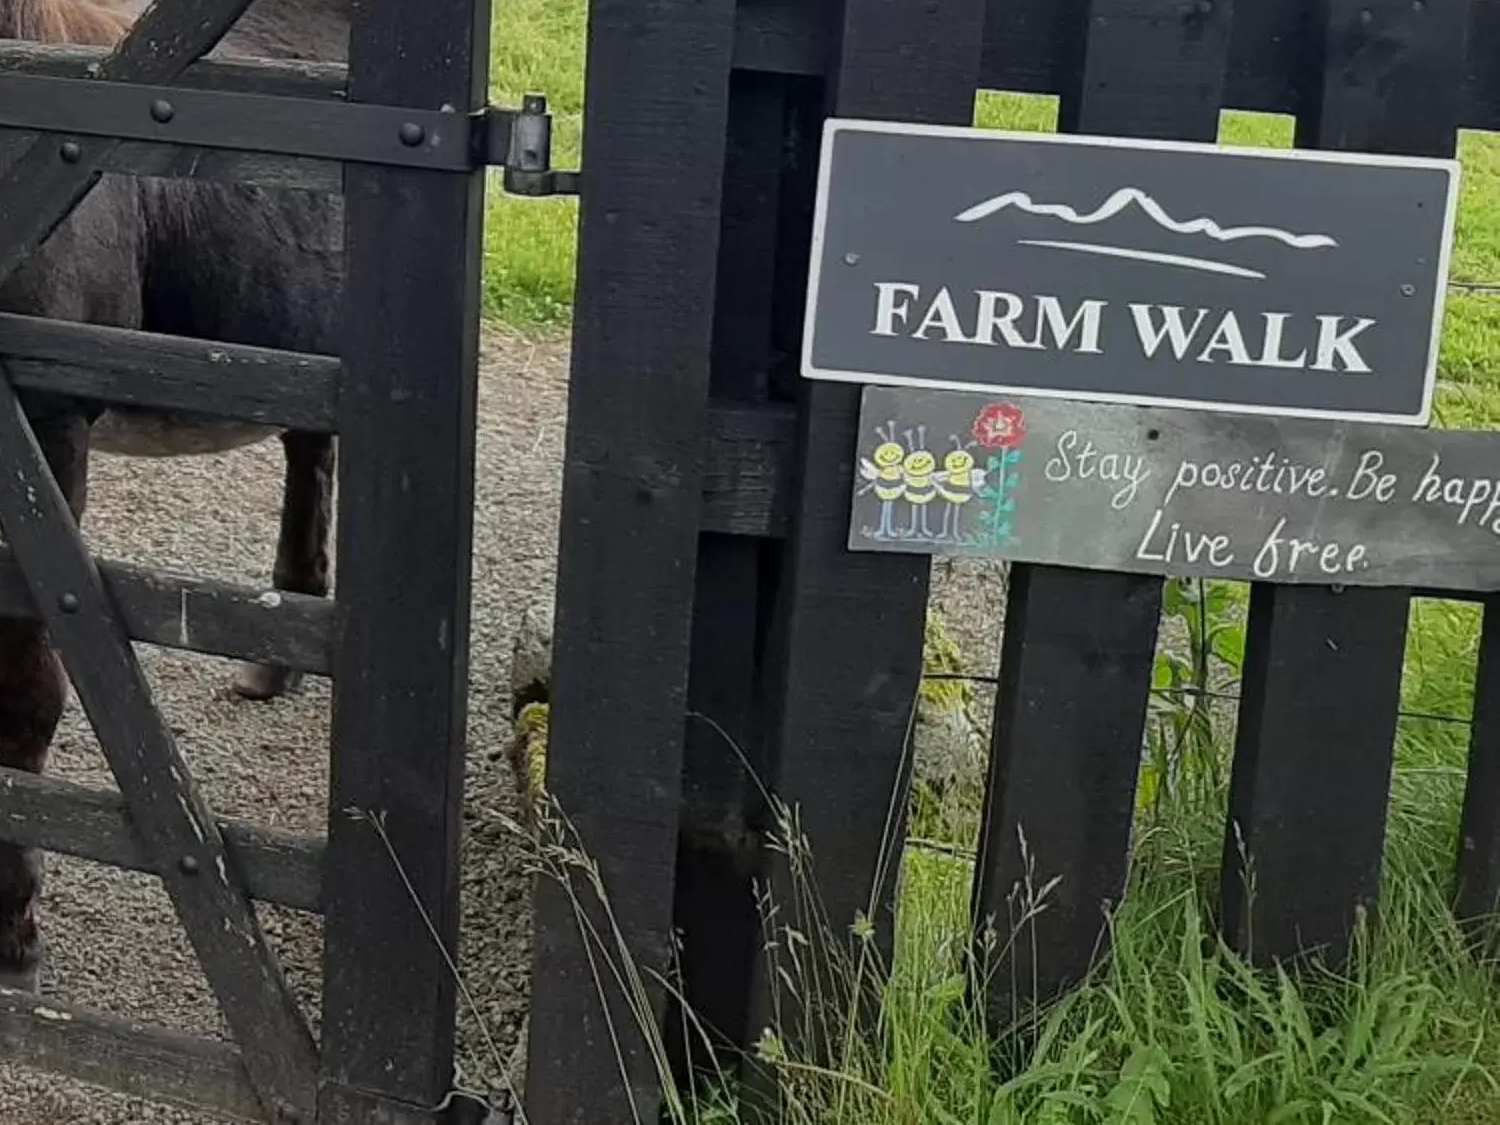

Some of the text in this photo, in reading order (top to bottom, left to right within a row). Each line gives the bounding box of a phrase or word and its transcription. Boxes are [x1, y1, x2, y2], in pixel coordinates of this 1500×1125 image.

[870, 282, 1377, 372] FARM WALK
[1045, 430, 1151, 509] Stay
[1346, 450, 1397, 502] Be
[1411, 452, 1500, 534] happ
[1136, 508, 1235, 567] Live
